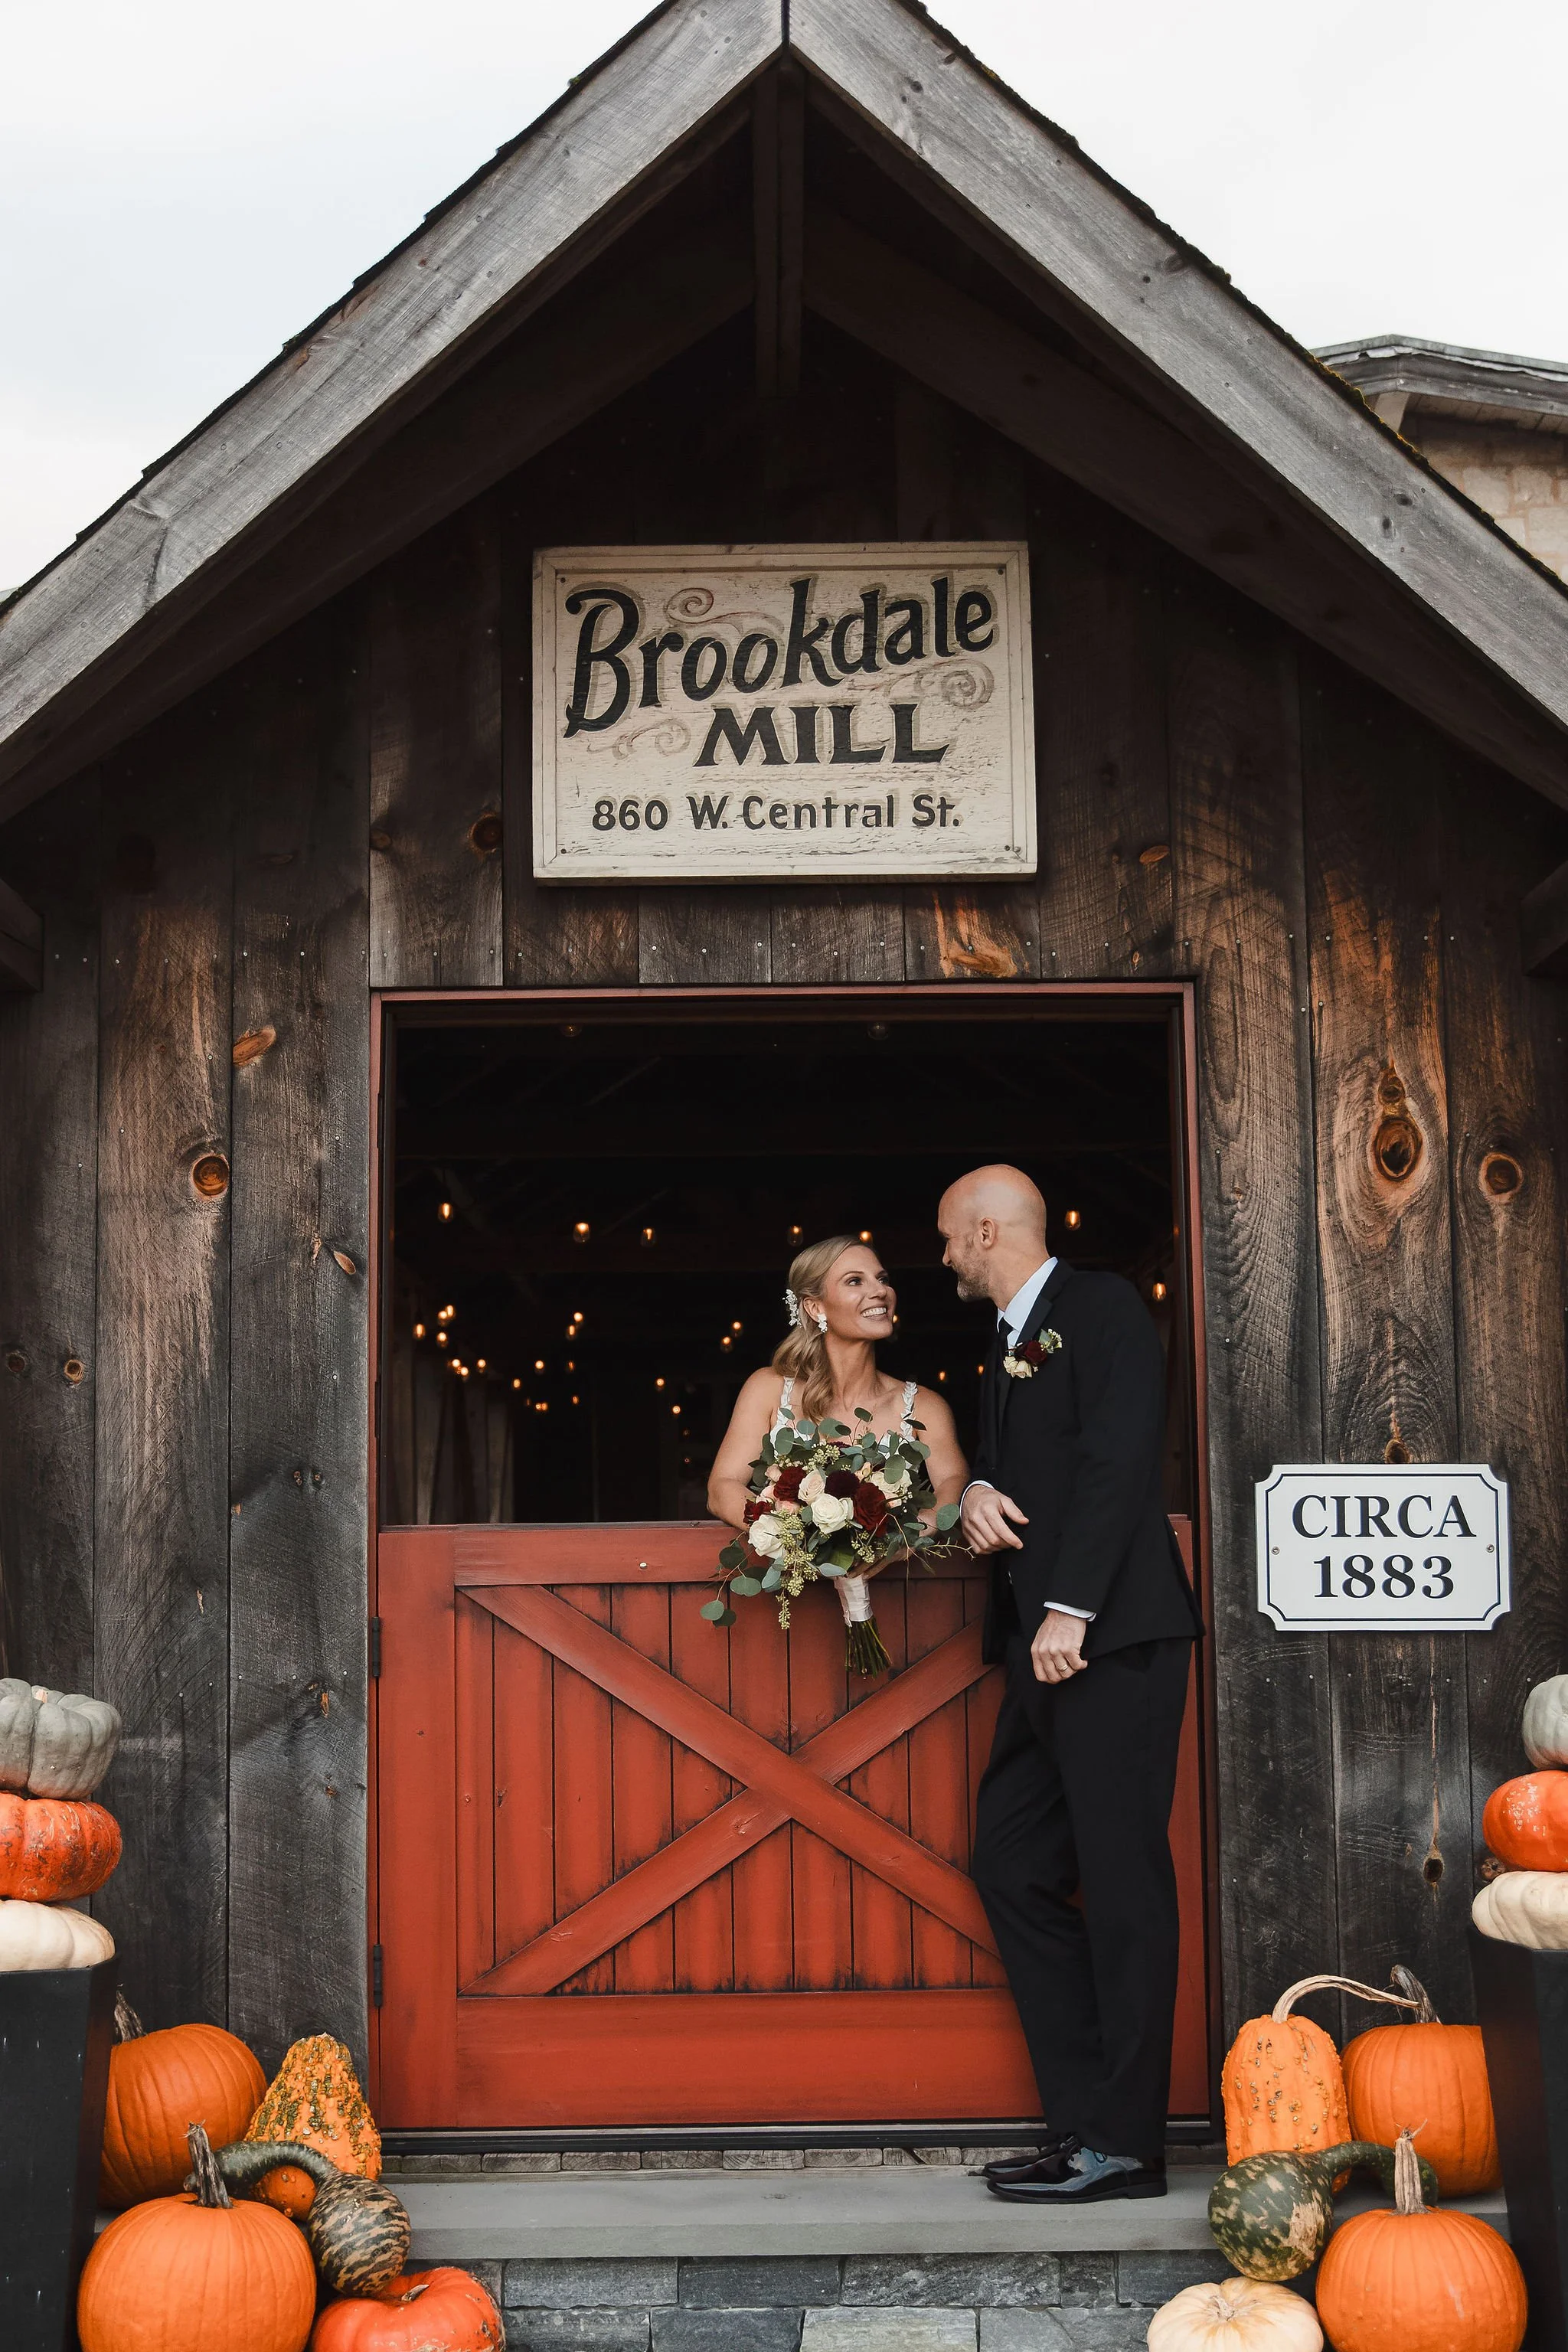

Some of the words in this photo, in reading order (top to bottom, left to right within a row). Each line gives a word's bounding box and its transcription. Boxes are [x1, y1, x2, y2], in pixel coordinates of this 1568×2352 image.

[564, 577, 995, 739] Brookdale
[692, 704, 950, 767] MILL
[591, 799, 669, 831] 860
[686, 795, 728, 830] W.
[742, 795, 895, 830] Central
[911, 794, 961, 828] St.
[1291, 1494, 1478, 1539] CIRCA
[1313, 1553, 1455, 1599] 1883
